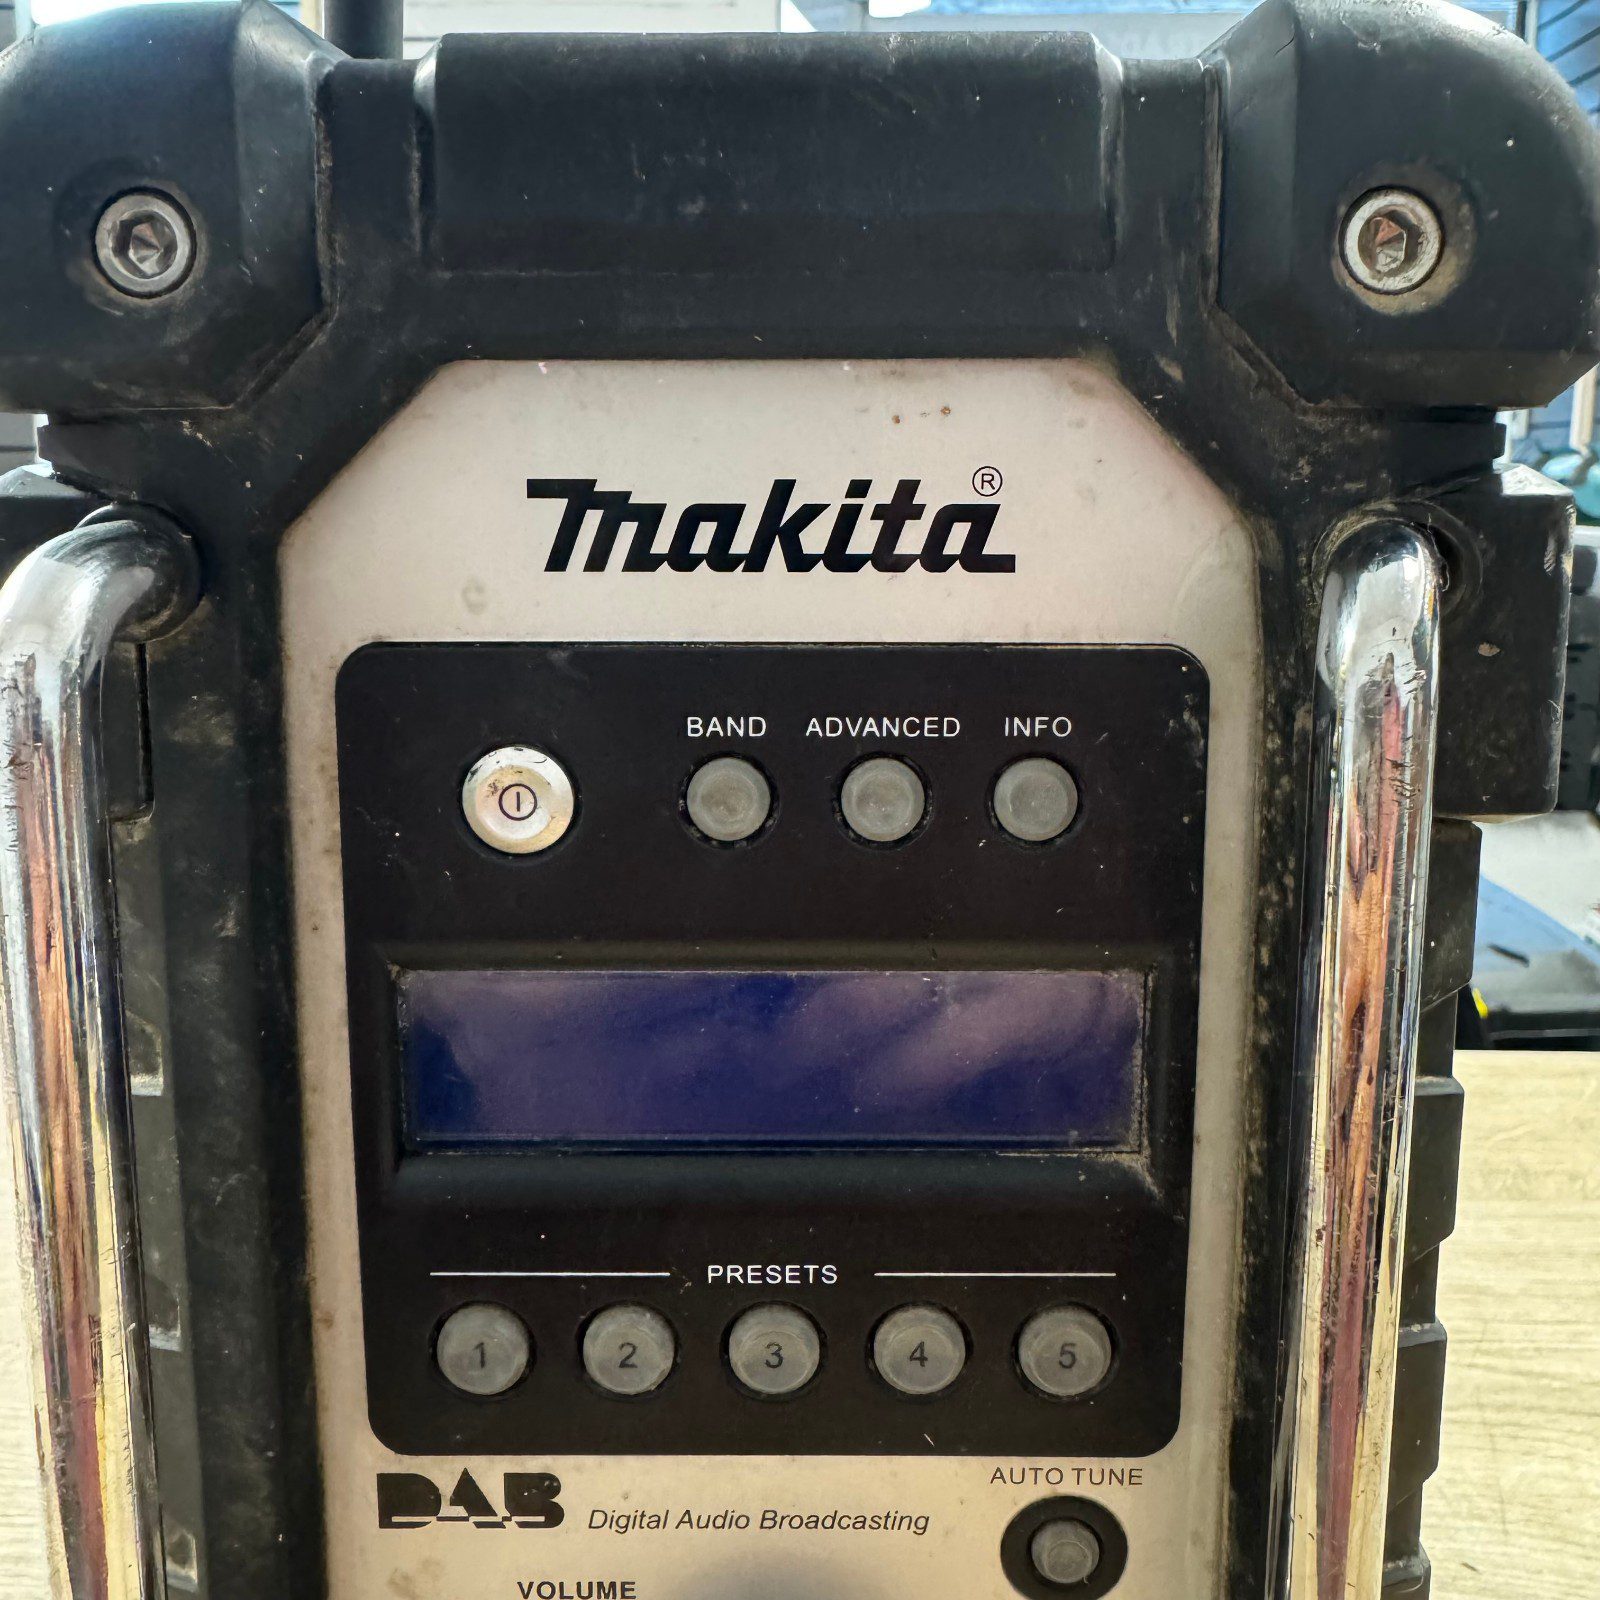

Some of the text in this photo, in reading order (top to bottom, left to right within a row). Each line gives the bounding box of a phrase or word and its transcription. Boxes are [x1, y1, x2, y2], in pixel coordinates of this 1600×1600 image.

[686, 715, 768, 739] BAND
[804, 715, 962, 739] ADVANCED
[1003, 715, 1073, 738] INFO
[706, 1263, 839, 1286] PRESETS
[473, 1341, 488, 1370] 1
[617, 1341, 639, 1370] 2
[763, 1341, 785, 1370] 3
[907, 1341, 930, 1369] 4
[1056, 1341, 1079, 1370] 5
[988, 1466, 1144, 1487] AUTO TUNE
[376, 1467, 565, 1529] DAB
[587, 1508, 932, 1536] Digital Audio Broadcasting
[515, 1580, 638, 1600] VOLUME
